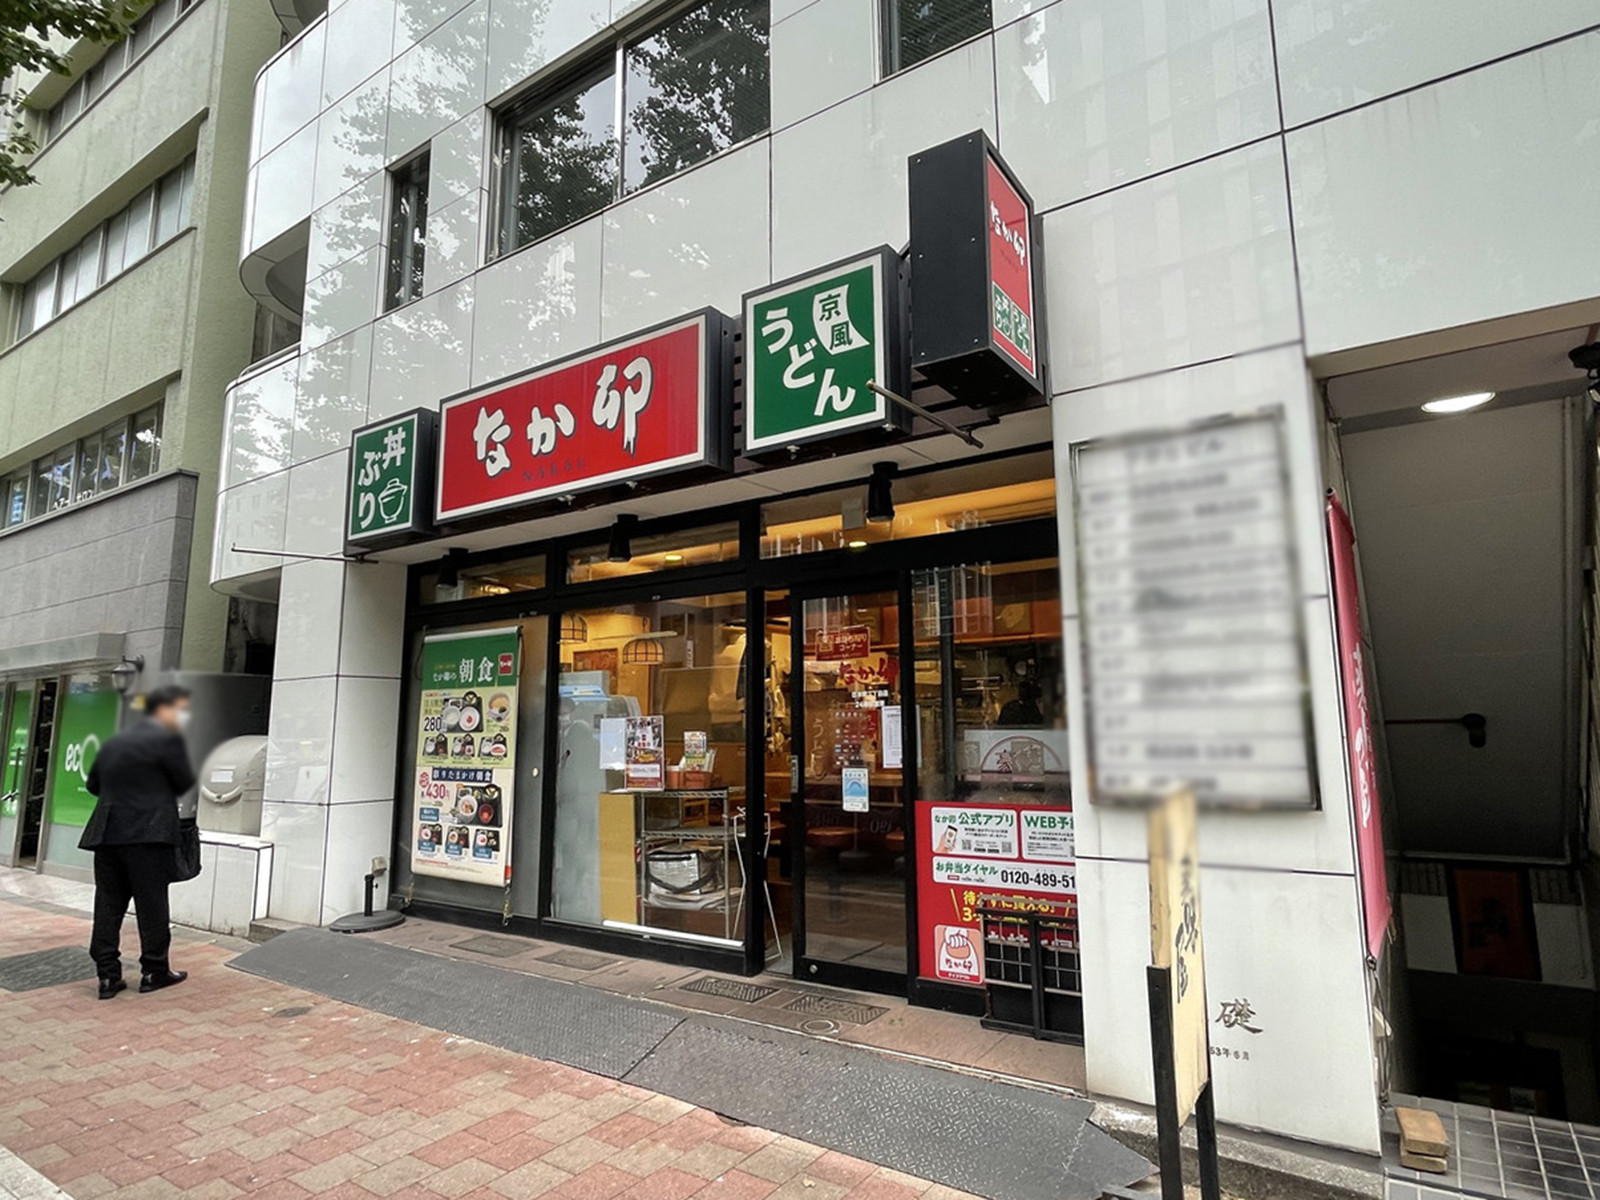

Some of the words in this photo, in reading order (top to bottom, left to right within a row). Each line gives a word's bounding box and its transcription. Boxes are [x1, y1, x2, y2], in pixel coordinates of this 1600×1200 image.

[818, 291, 856, 352] 京風
[760, 307, 857, 418] うどん
[472, 355, 654, 478] なか卯
[357, 426, 406, 530] 丼ぶり
[459, 656, 495, 683] 朝食
[958, 811, 1014, 827] 公式アプリ
[935, 862, 998, 876] お弁当ダイヤル
[1215, 998, 1263, 1035] 礎
